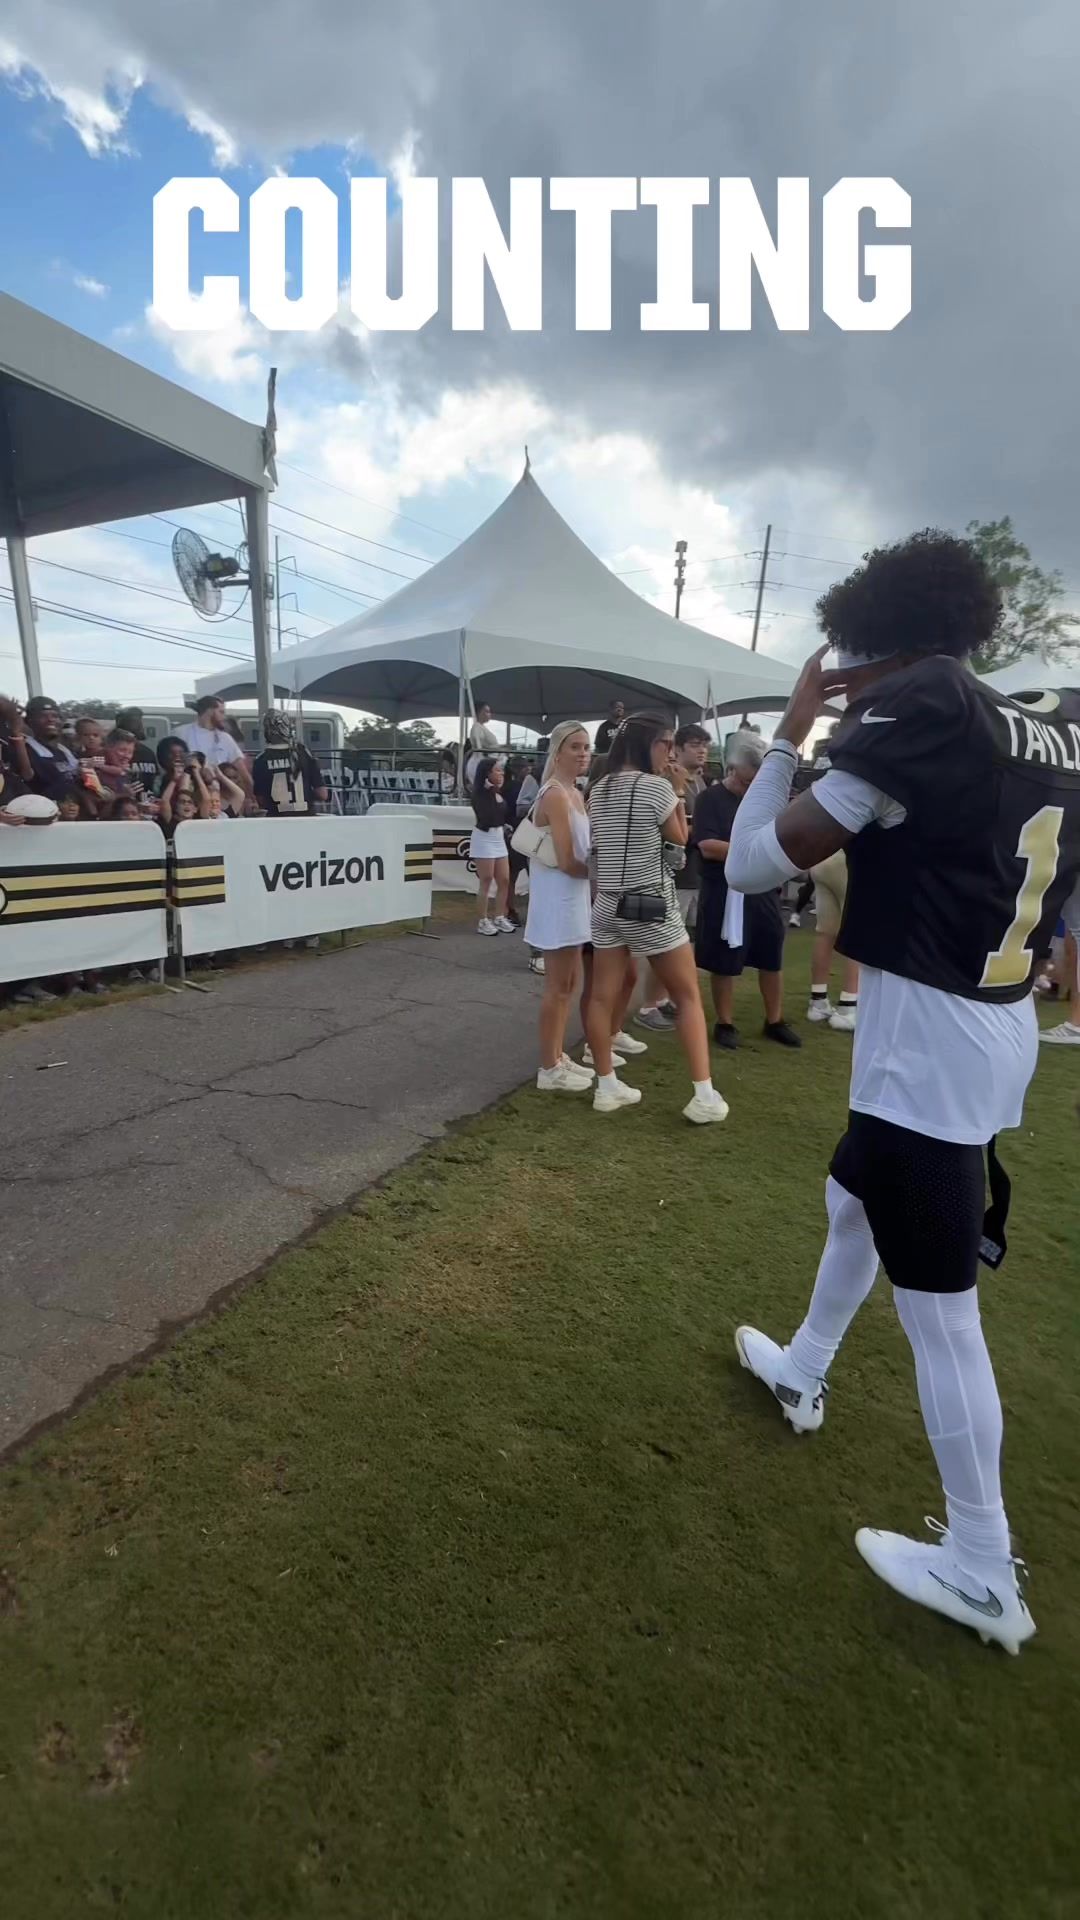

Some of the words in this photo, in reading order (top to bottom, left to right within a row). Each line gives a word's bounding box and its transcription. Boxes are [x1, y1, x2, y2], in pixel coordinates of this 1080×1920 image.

[267, 758, 292, 769] KAMA
[271, 771, 308, 812] 41
[259, 851, 384, 892] verizon
[978, 805, 1064, 987] 1
